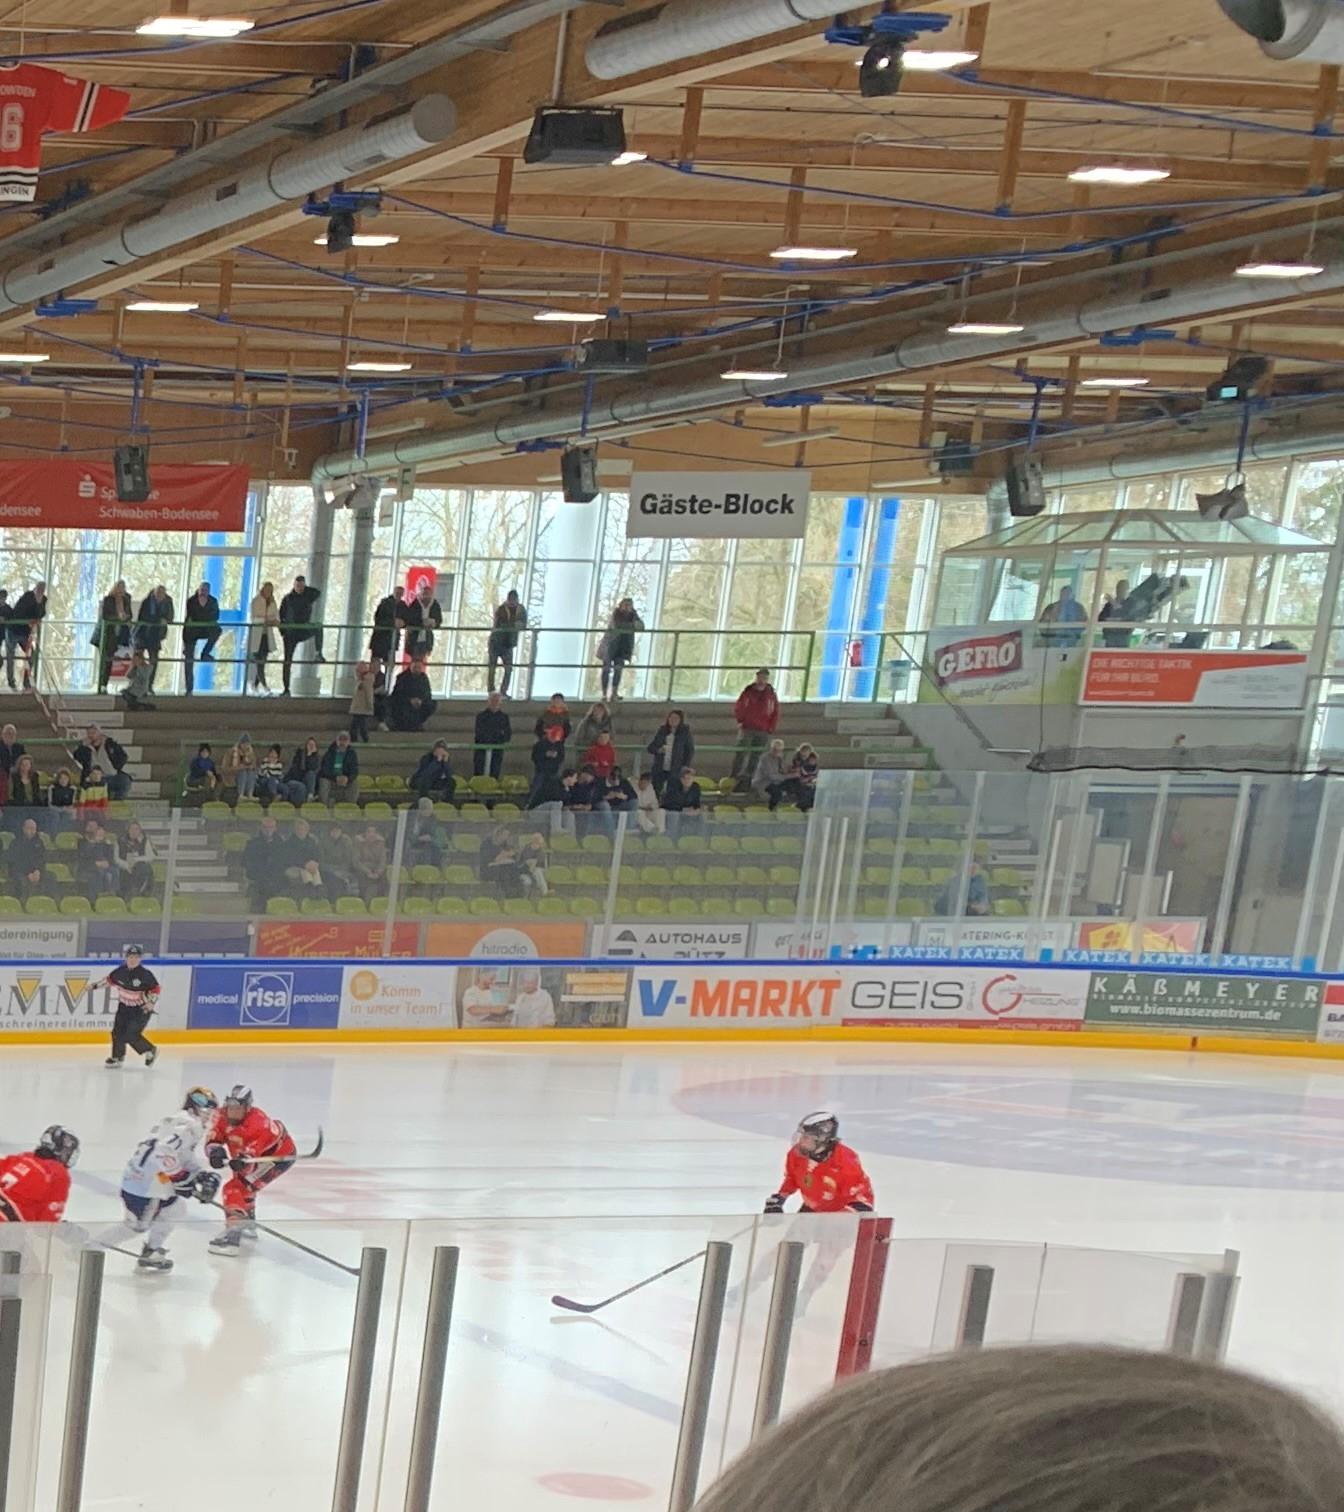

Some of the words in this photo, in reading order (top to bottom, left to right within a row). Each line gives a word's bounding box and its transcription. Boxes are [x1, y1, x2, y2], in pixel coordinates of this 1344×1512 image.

[639, 493, 795, 515] Gäste-Block
[99, 506, 220, 522] Schwaben-Bodensee
[937, 641, 1018, 678] GEFRO
[644, 932, 743, 945] AUTOHAUS
[481, 942, 528, 955] hitradio
[890, 946, 950, 960] KATEK
[961, 947, 1023, 961] KATEK
[1065, 949, 1130, 964] KATEK
[1142, 951, 1210, 967] KATEK
[1223, 954, 1292, 970] KATEK
[197, 993, 239, 1005] medical
[245, 987, 288, 1008] risa
[381, 985, 422, 998] Komm
[637, 978, 843, 1018] V-MARKT
[850, 980, 965, 1010] GEIS
[292, 993, 339, 1006] precision
[350, 1004, 364, 1014] in
[367, 1004, 400, 1015] unser
